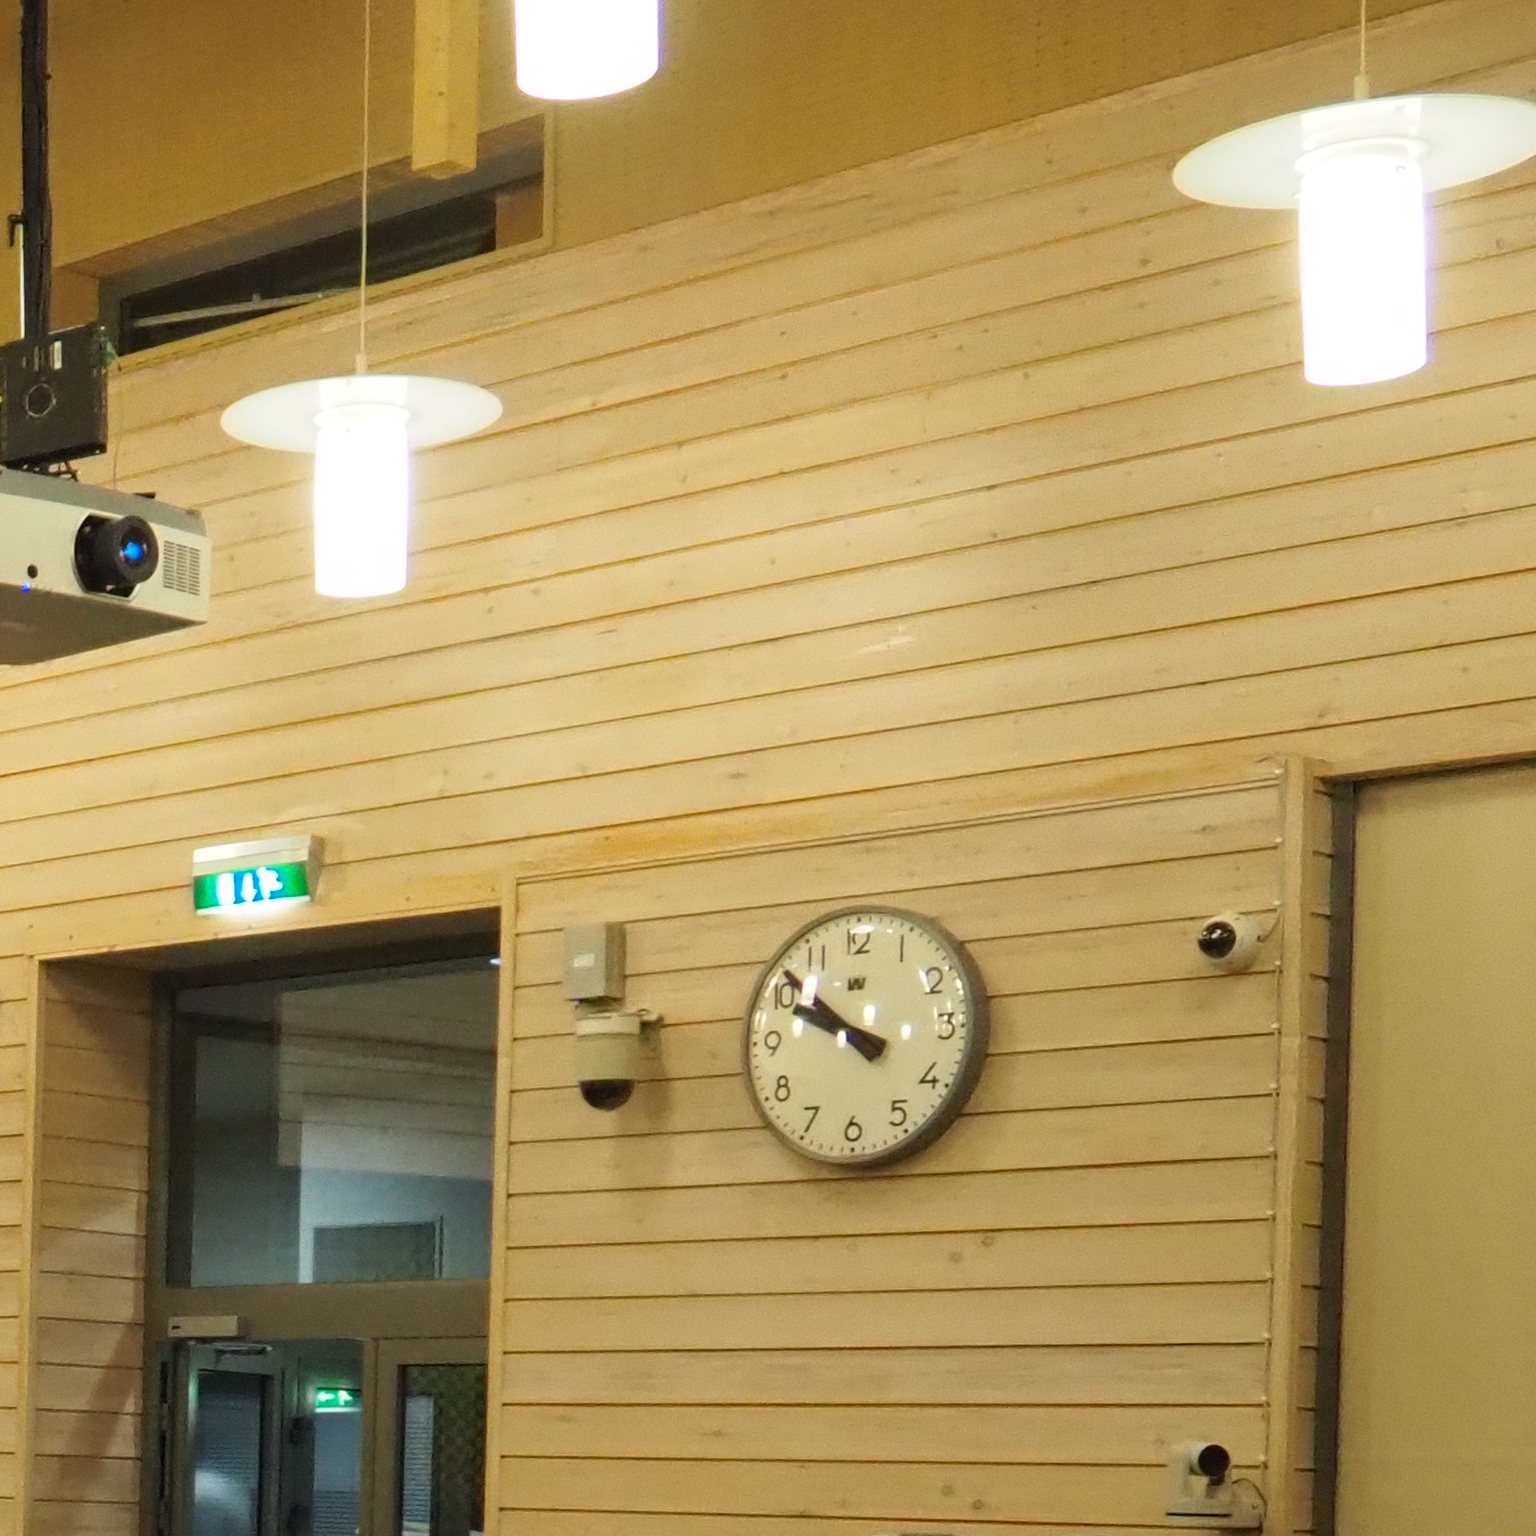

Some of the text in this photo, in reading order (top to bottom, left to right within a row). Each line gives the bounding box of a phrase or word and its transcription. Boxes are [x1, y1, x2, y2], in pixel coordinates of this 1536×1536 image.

[847, 928, 871, 955] 12
[808, 944, 826, 971] 11
[924, 966, 944, 994] 2
[773, 981, 795, 1010] 10
[937, 1012, 956, 1040] 3
[764, 1030, 782, 1057] 9
[774, 1075, 791, 1102] 8
[918, 1061, 939, 1090] 4
[803, 1105, 820, 1133] 7
[889, 1099, 908, 1127] 5
[844, 1115, 863, 1142] 6
